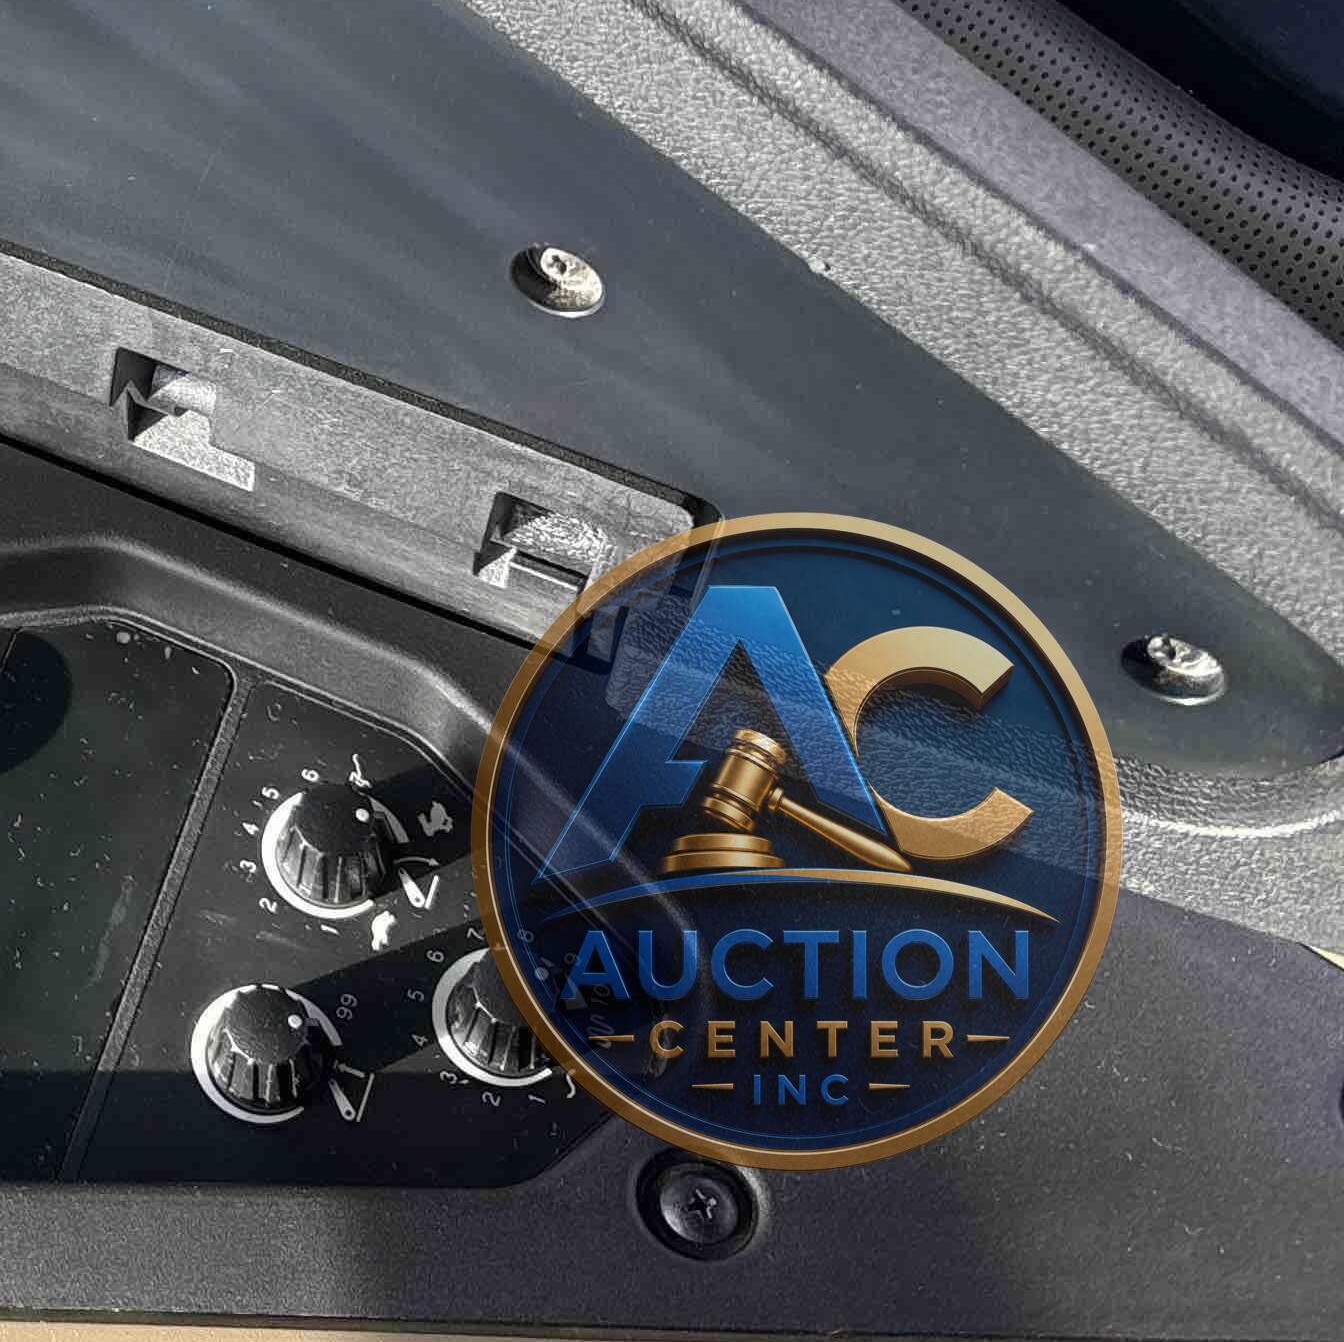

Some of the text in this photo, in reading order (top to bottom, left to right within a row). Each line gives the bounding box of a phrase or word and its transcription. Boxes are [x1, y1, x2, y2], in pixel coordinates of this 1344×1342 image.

[301, 768, 319, 783] 6
[262, 787, 280, 800] 5
[242, 822, 260, 836] 4
[239, 859, 257, 874] 3
[259, 897, 278, 914] 2
[467, 927, 484, 940] 7
[426, 948, 444, 963] 6
[407, 987, 425, 1002] 5
[336, 993, 358, 1020] 99
[411, 1033, 429, 1047] 4
[439, 1071, 458, 1085] 3
[481, 1090, 501, 1107] 2
[527, 1092, 547, 1104] 1
